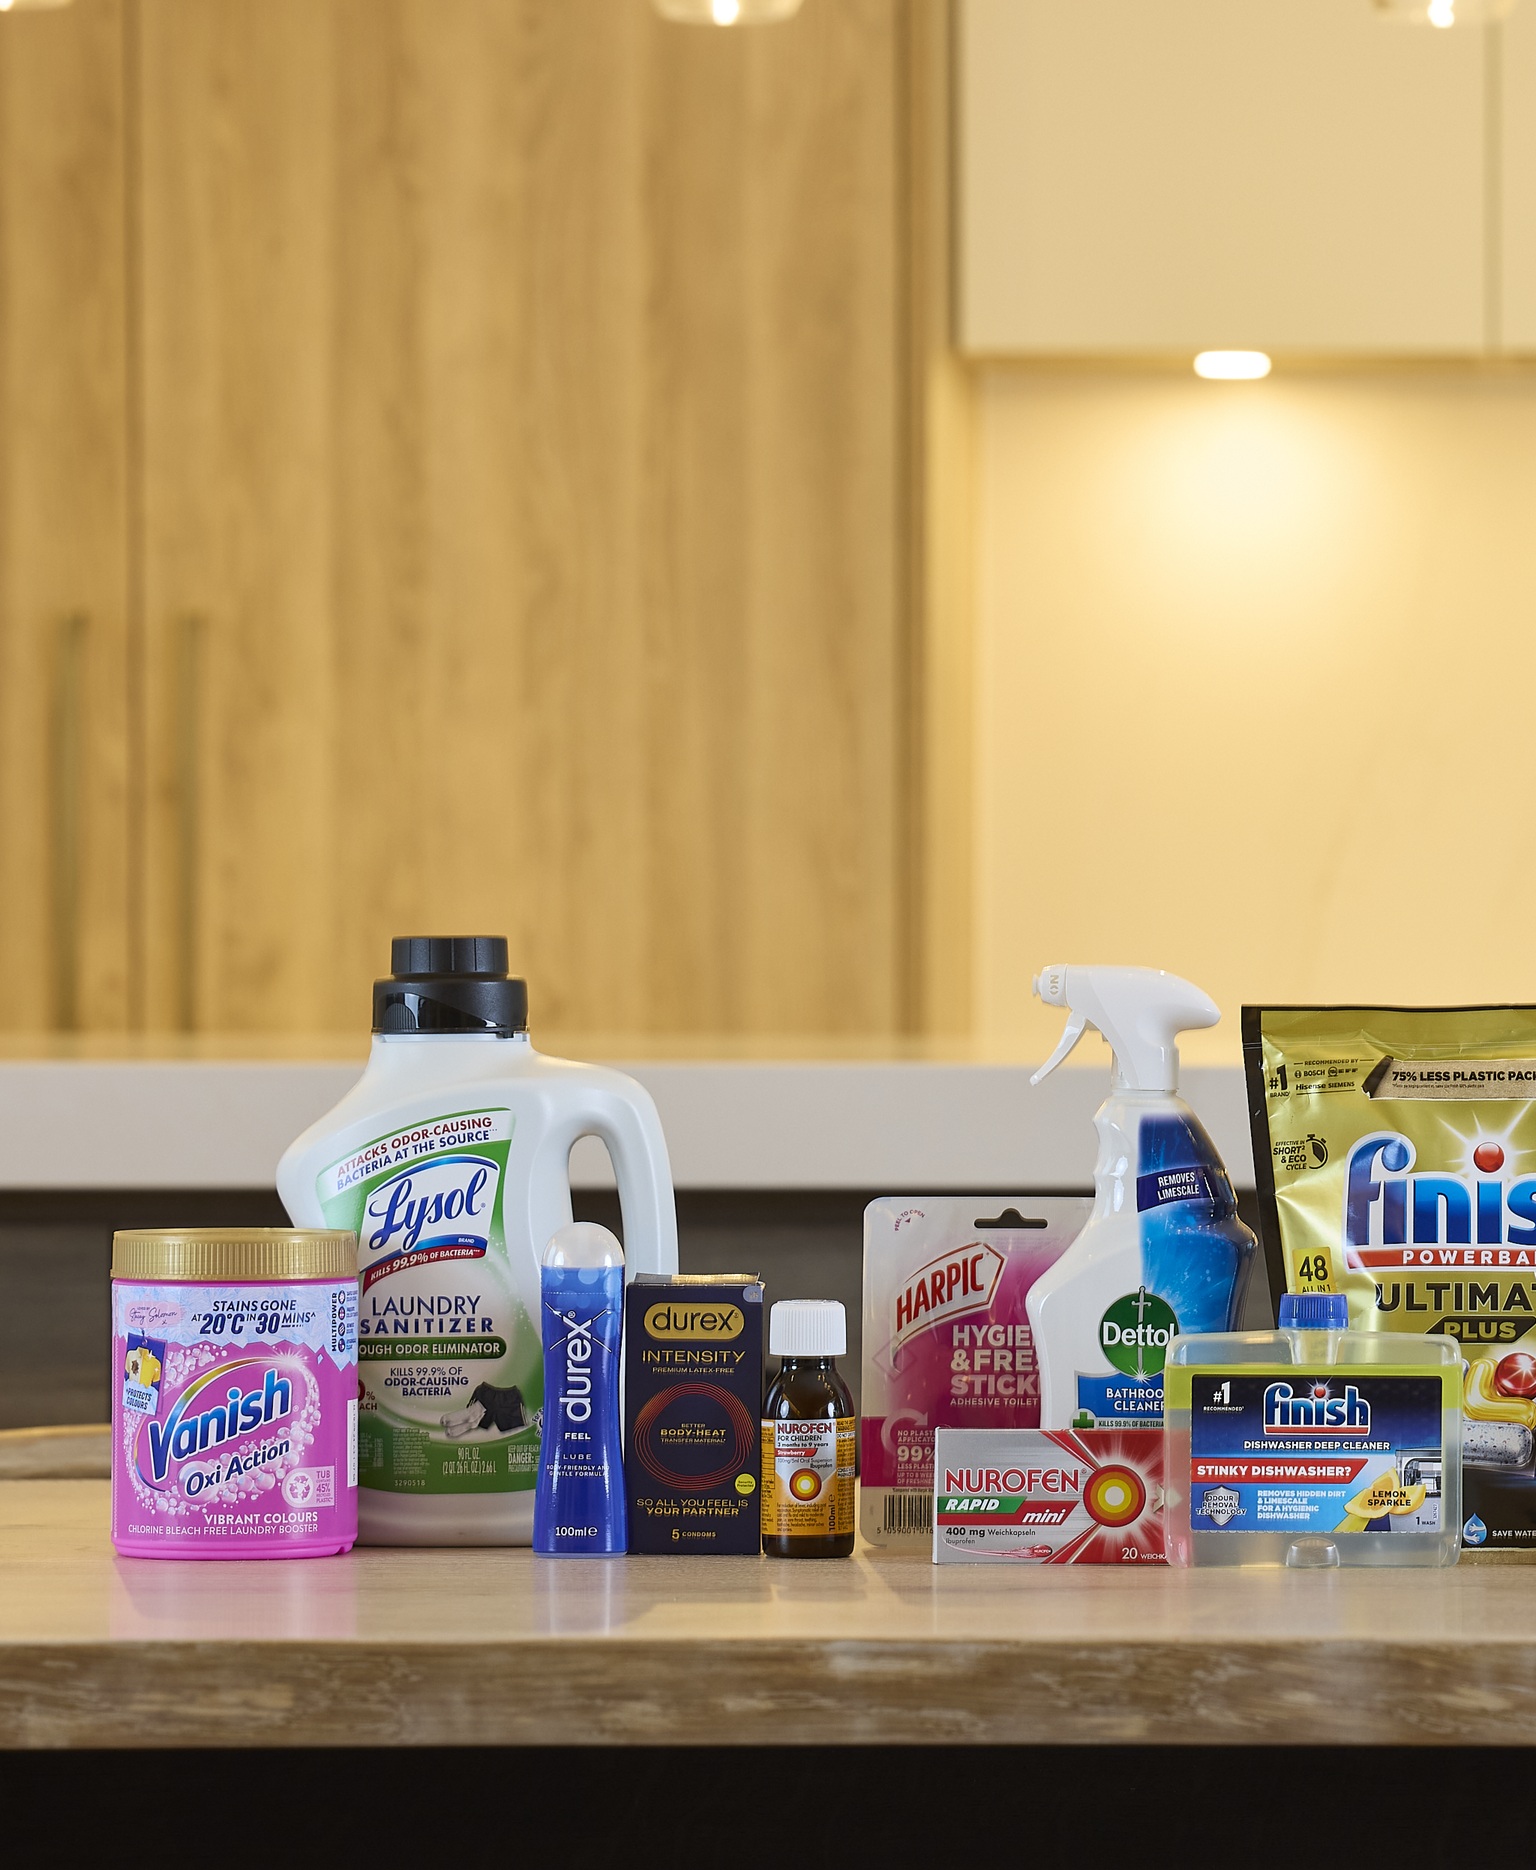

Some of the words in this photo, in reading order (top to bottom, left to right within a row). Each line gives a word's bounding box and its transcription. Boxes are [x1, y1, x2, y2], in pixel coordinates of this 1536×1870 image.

[1269, 1063, 1288, 1091] #1
[337, 1143, 388, 1179] ATTACKS
[391, 1116, 493, 1151] ODOR-CAUSING
[336, 1155, 392, 1192] BACTERIA
[394, 1149, 410, 1164] AT
[413, 1141, 436, 1157] THE
[1285, 1162, 1307, 1171] CYCLE
[1157, 1171, 1196, 1188] REMOVES
[1157, 1185, 1200, 1202] LIMESCALE
[368, 1167, 488, 1252] Lysol
[1298, 1254, 1330, 1283] 48
[896, 1251, 985, 1334] HARPIC
[213, 1300, 257, 1312] STAINS
[260, 1299, 296, 1311] GONE
[372, 1295, 482, 1317] LAUNDRY
[652, 1306, 736, 1331] durex
[359, 1317, 494, 1335] SANITIZER
[1443, 1320, 1517, 1340] PLUS
[952, 1324, 1035, 1347] HYGIE
[1102, 1320, 1175, 1347] Dettol
[642, 1350, 747, 1363] INTENSITY
[652, 1366, 687, 1374] PREMIUM
[688, 1366, 735, 1375] LATEX-FREE
[384, 1376, 469, 1388] ODOR-CAUSING
[950, 1374, 1041, 1395] STICK
[402, 1386, 452, 1398] BACTERIA
[1213, 1380, 1231, 1405] #1
[950, 1397, 1001, 1406] ADHESIVE
[1002, 1397, 1039, 1406] TOILET
[1264, 1381, 1372, 1428] finish
[147, 1367, 292, 1482] Vanish
[777, 1422, 832, 1435] NUROFEN
[564, 1432, 592, 1440] FEEL
[660, 1428, 727, 1438] BODY-HEAT
[777, 1434, 790, 1442] FOR
[790, 1434, 823, 1442] CHILDREN
[1243, 1440, 1313, 1451] DISHWASHER
[1314, 1441, 1342, 1451] DEEP
[1342, 1441, 1391, 1452] CLEANER
[777, 1449, 806, 1458] Strawberry
[185, 1464, 222, 1497] Oxi
[224, 1439, 290, 1482] Action
[316, 1470, 330, 1479] TUB
[1196, 1464, 1249, 1477] STINKY
[1250, 1465, 1353, 1478] DISHWASHER?
[945, 1468, 1079, 1493] NUROFEN
[1372, 1490, 1407, 1498] LEMON
[945, 1498, 1001, 1511] RAPID
[1367, 1498, 1412, 1507] SPARKLE
[204, 1514, 260, 1525] VIBRANT
[264, 1511, 318, 1524] COLOURS
[646, 1507, 682, 1517] YOUR
[682, 1506, 740, 1516] PARTNER
[1022, 1508, 1067, 1524] mini
[945, 1527, 967, 1537] 400
[969, 1529, 985, 1539] mg
[988, 1527, 1036, 1539] Weichkapseln
[1492, 1529, 1513, 1537] SAVE
[945, 1537, 976, 1546] Ibuprofen
